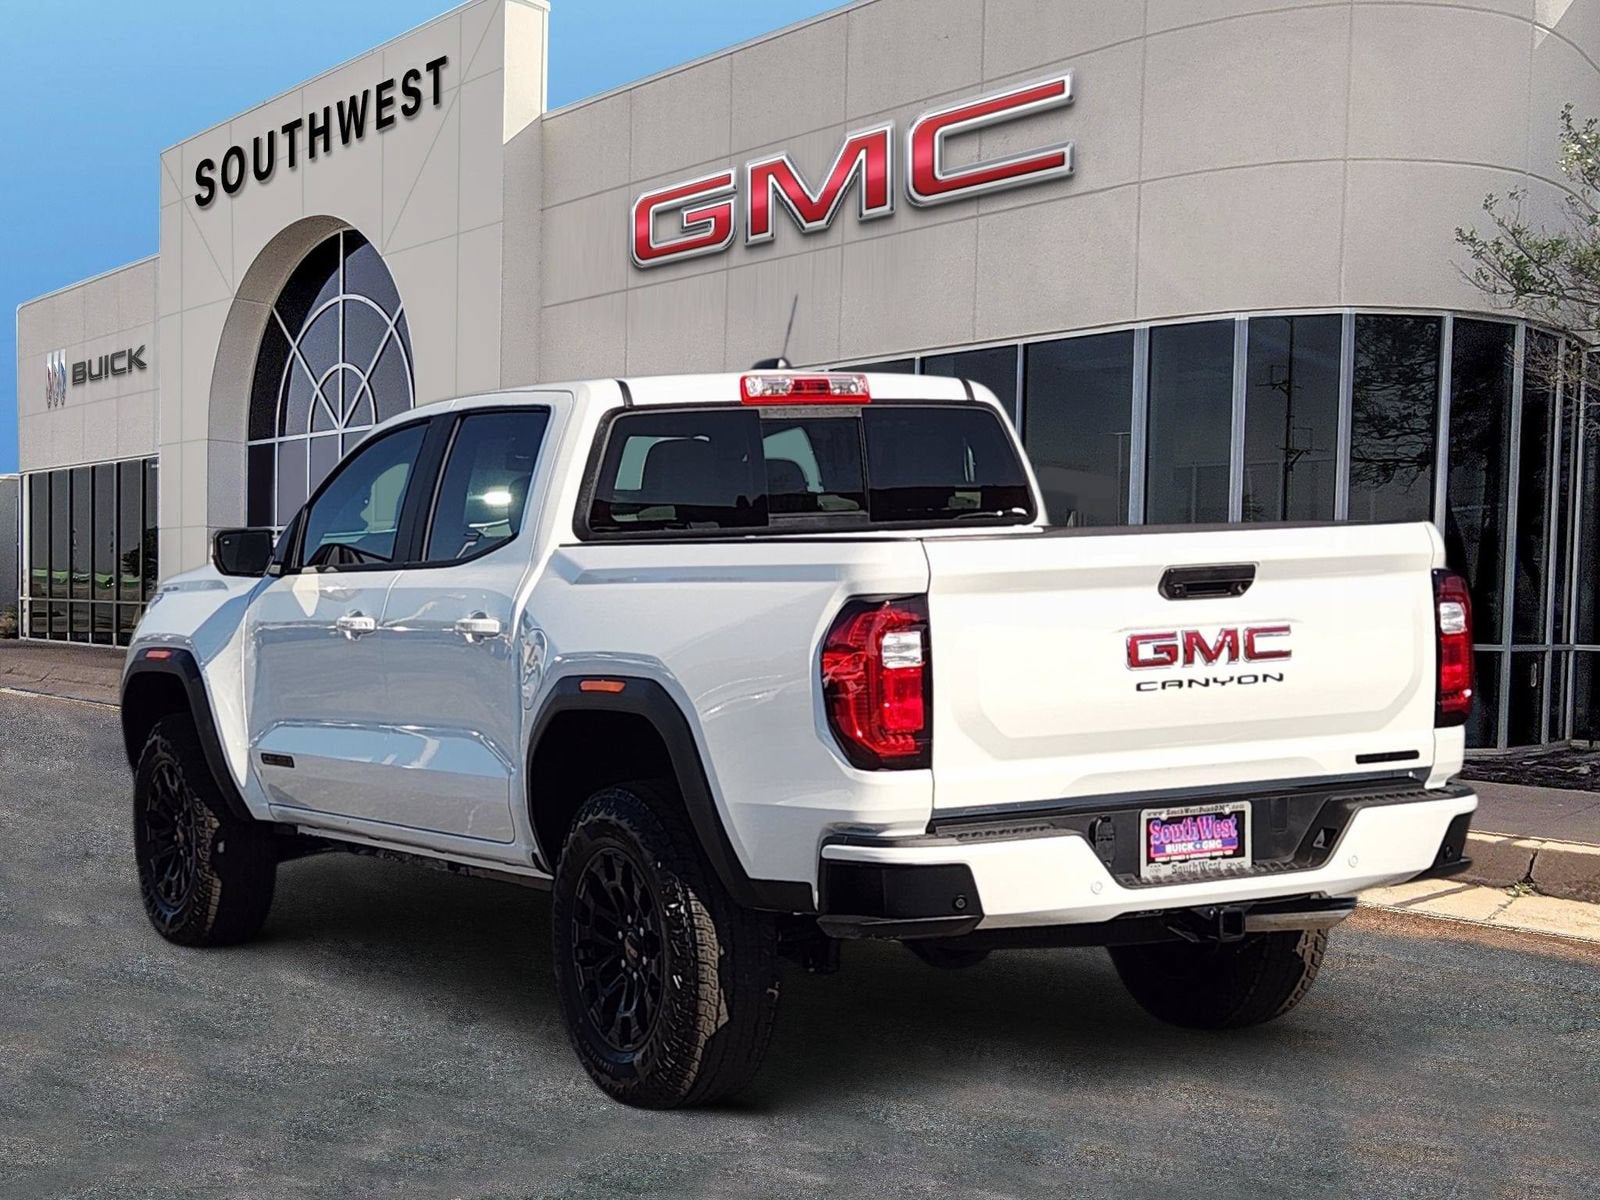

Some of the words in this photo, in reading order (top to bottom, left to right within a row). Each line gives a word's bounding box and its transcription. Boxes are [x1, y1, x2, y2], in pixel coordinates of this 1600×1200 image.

[194, 55, 447, 206] SOUTHWEST
[630, 69, 1076, 268] GMC
[71, 344, 147, 386] BUICK
[1126, 624, 1292, 671] GMC
[1135, 673, 1284, 692] CANYON
[1165, 841, 1195, 853] BUICK
[1202, 839, 1222, 851] GMC
